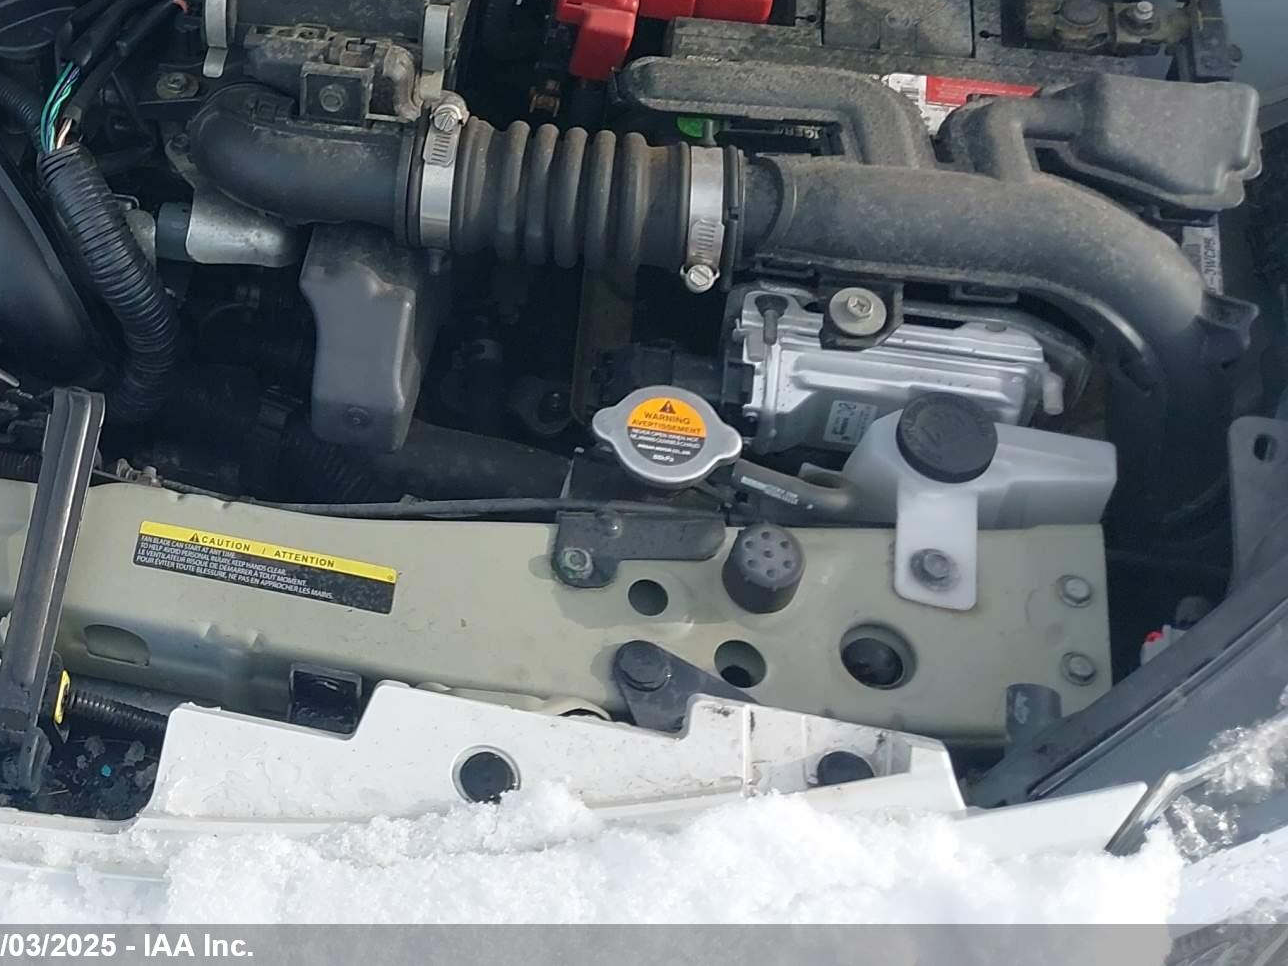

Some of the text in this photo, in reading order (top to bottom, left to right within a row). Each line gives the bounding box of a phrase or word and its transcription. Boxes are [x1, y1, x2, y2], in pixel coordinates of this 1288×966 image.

[632, 419, 701, 434] AVERTISSEMENT
[644, 411, 691, 425] WARNING
[172, 540, 184, 548] CAN
[185, 542, 201, 551] START
[202, 536, 251, 552] CAUTION
[274, 550, 335, 568] ATTENTION
[146, 549, 186, 563] VENTILATEUR
[186, 557, 208, 568] RISQUE
[209, 561, 218, 569] DE
[259, 571, 277, 580] TOUT
[163, 546, 181, 555] AVOID
[182, 549, 209, 561] PERSONAL
[246, 562, 266, 571] HANDS
[136, 555, 153, 564] POUR
[176, 562, 195, 572] TOUTE
[228, 572, 237, 580] NE
[238, 574, 249, 583] PAS
[260, 578, 298, 593] APPROCHER
[299, 586, 310, 595] LES
